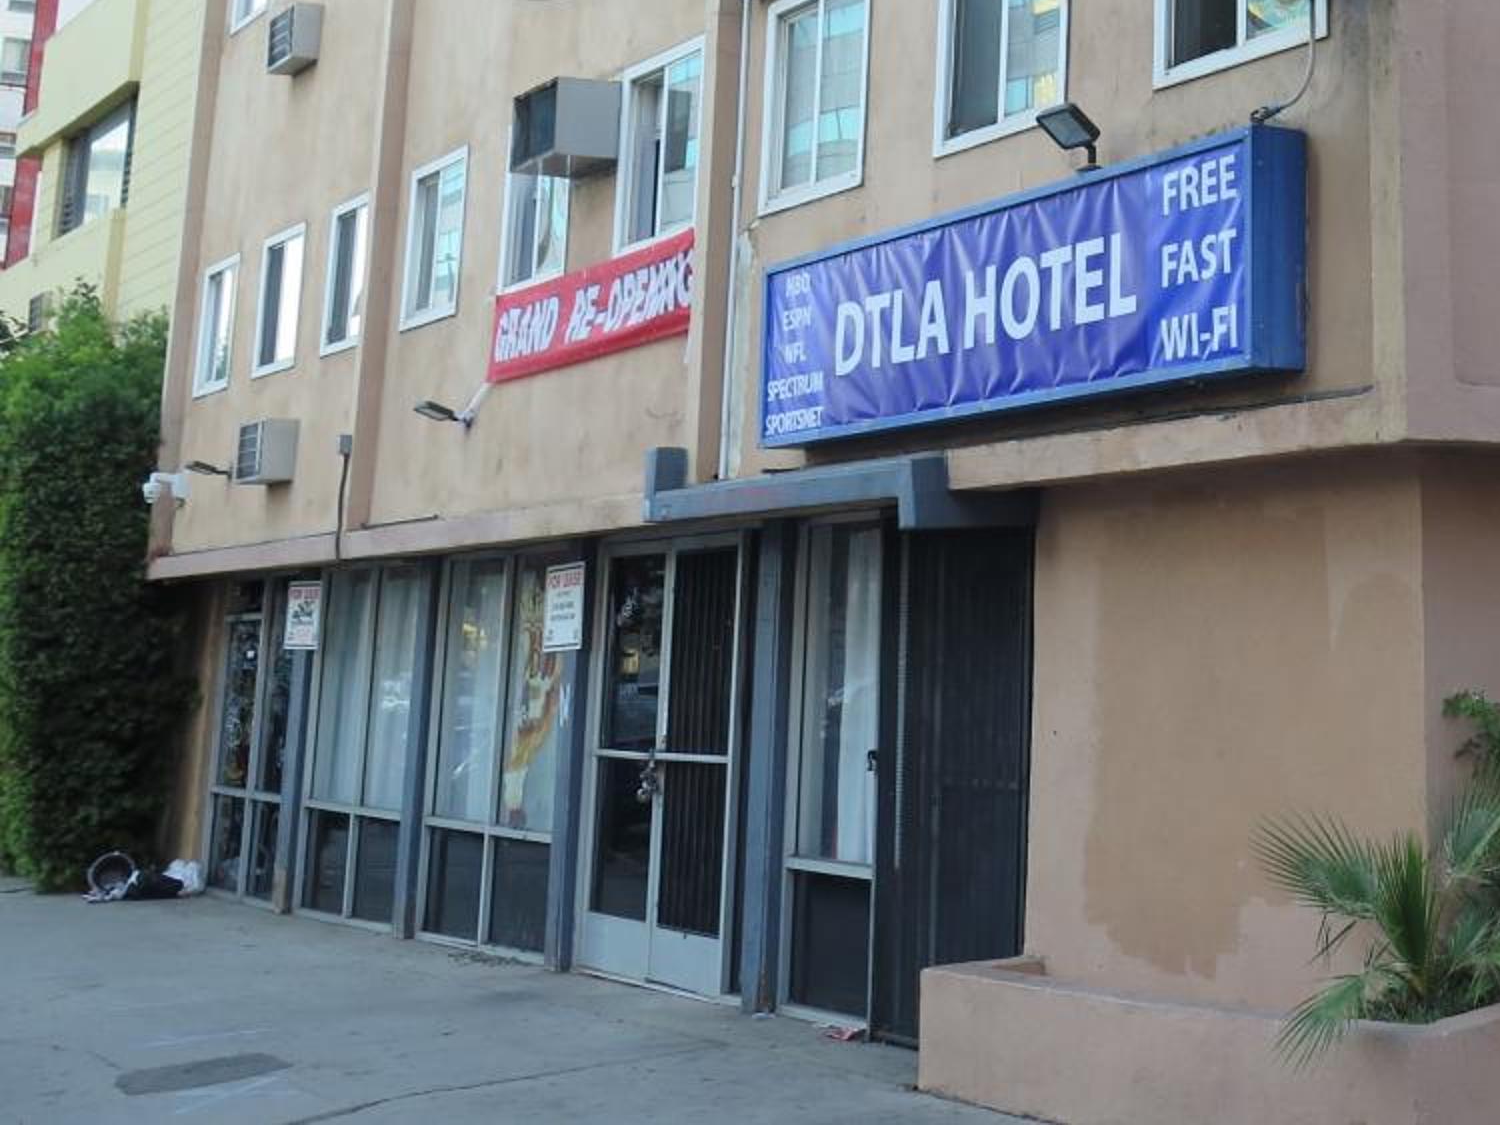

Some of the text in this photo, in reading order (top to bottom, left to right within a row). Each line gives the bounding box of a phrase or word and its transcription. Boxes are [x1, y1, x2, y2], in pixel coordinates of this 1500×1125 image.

[1161, 154, 1238, 216] FREE
[1161, 228, 1238, 289] FAST
[494, 295, 560, 363] GRAND
[783, 306, 813, 332] ESPN
[834, 232, 1138, 377] DTLA HOTEL
[1160, 304, 1238, 362] WI-FI
[767, 371, 824, 403] SPECTRUM
[766, 407, 825, 436] SPORTSNET
